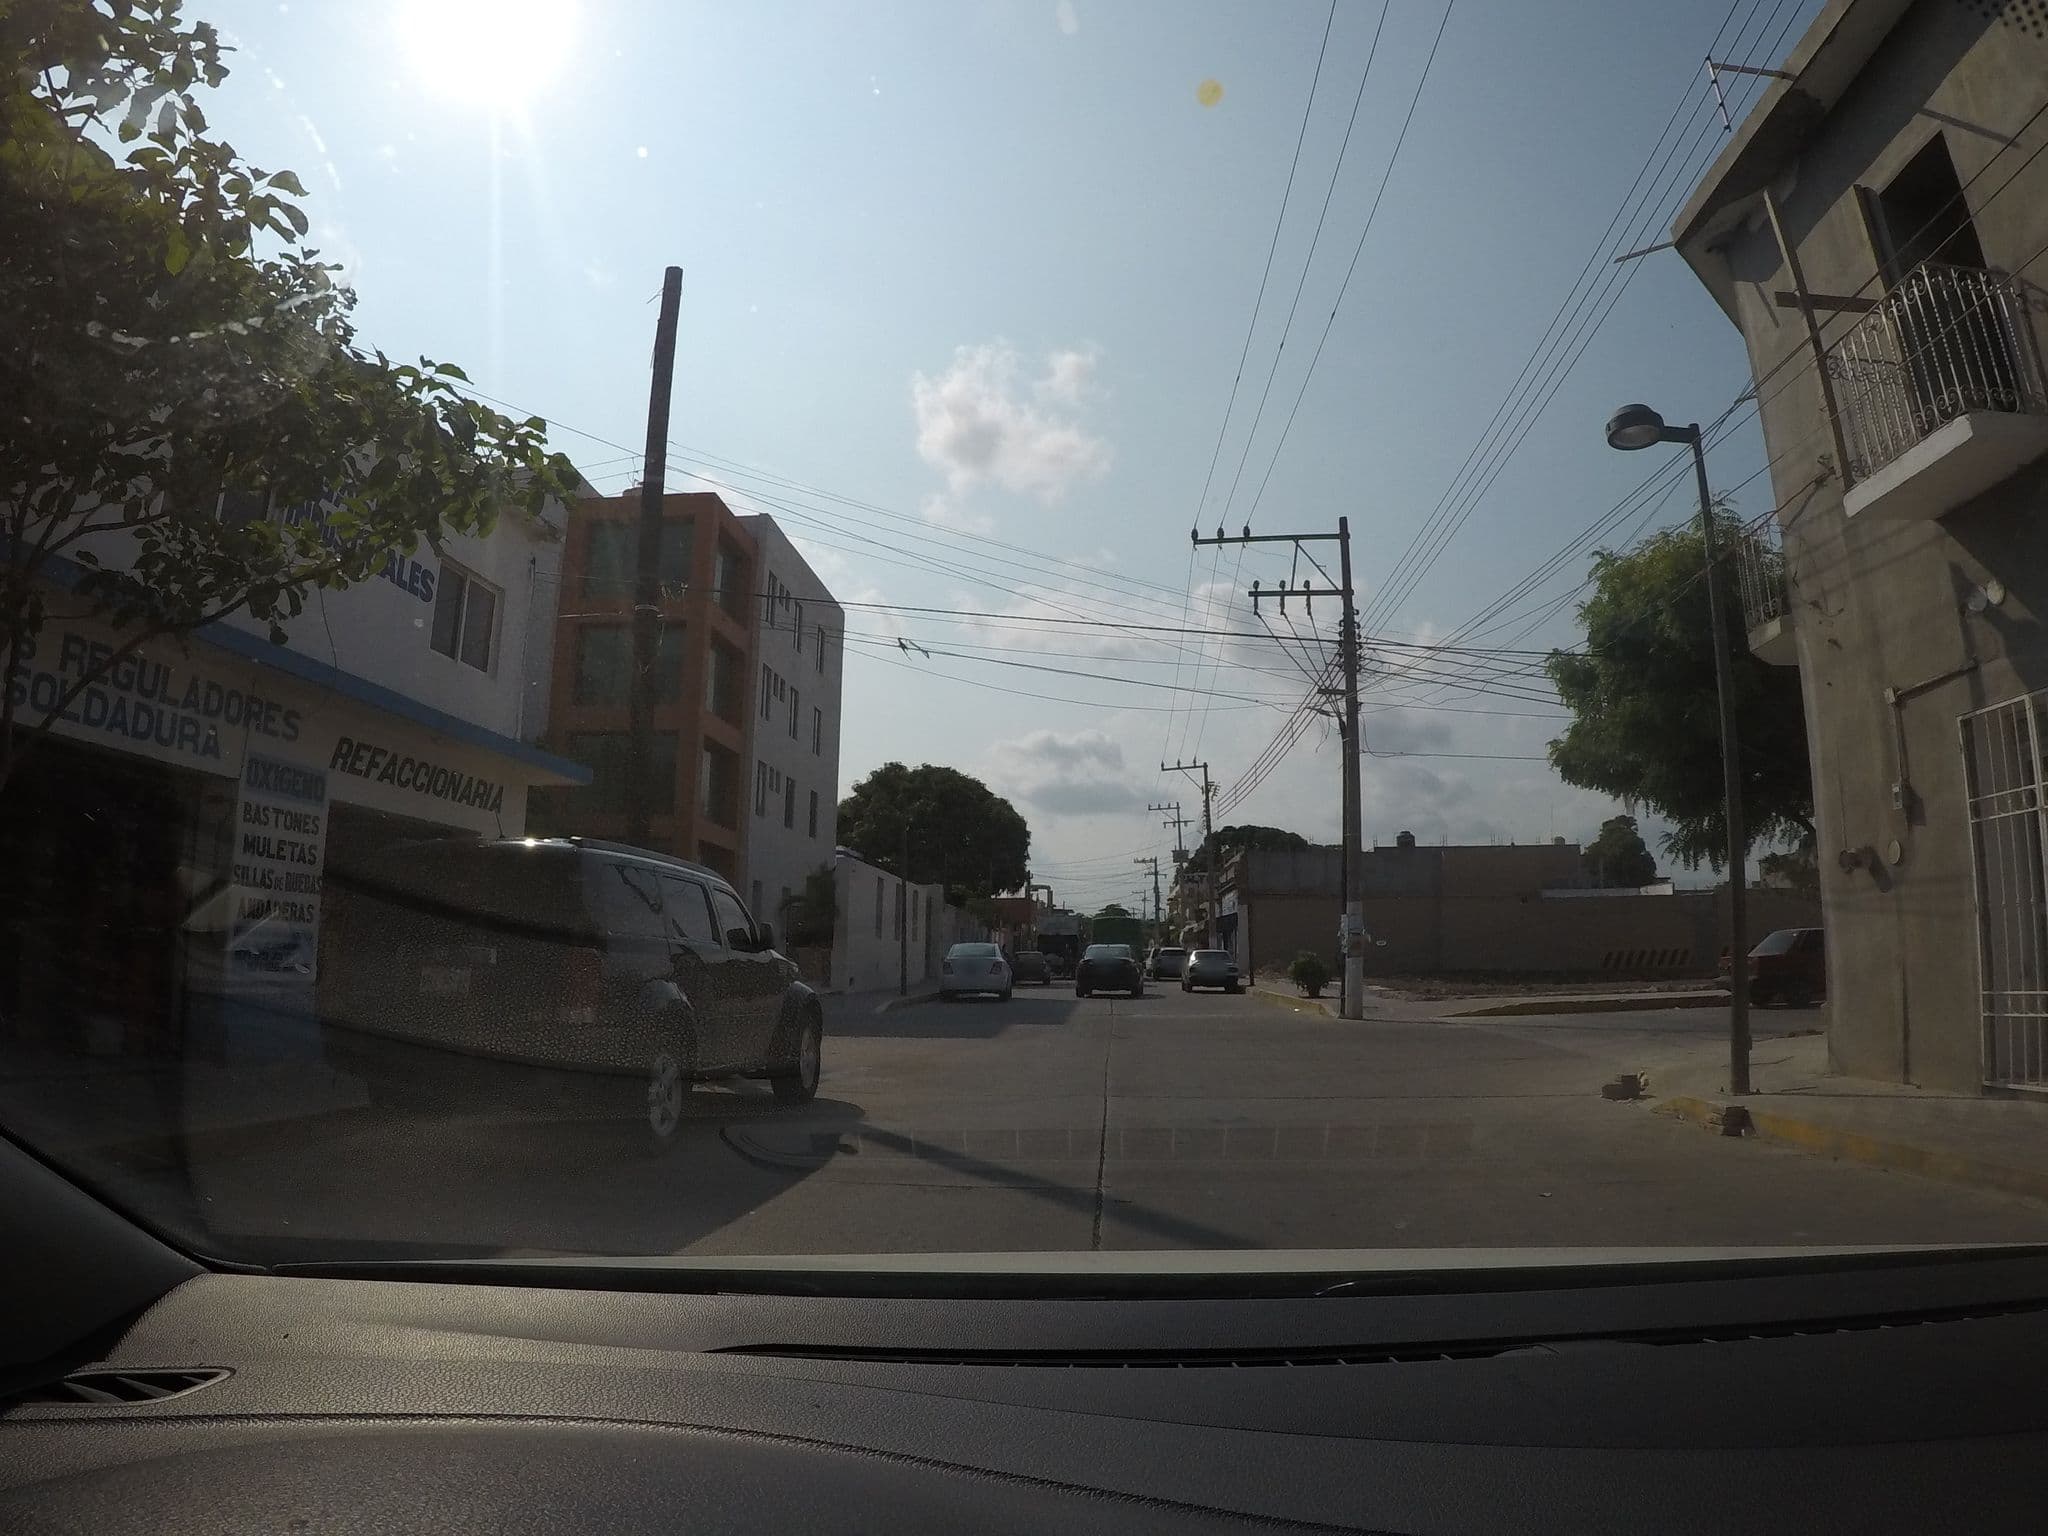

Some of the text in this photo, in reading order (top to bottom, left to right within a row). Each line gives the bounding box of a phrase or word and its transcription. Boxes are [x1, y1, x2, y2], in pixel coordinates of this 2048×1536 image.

[11, 664, 221, 760] SOLDADURA
[59, 632, 302, 743] REGULADORES
[329, 736, 503, 813] REFACCIONARIA
[242, 801, 320, 836] BASTONES
[233, 864, 274, 890] SILLAS
[242, 833, 318, 866] MULETAS
